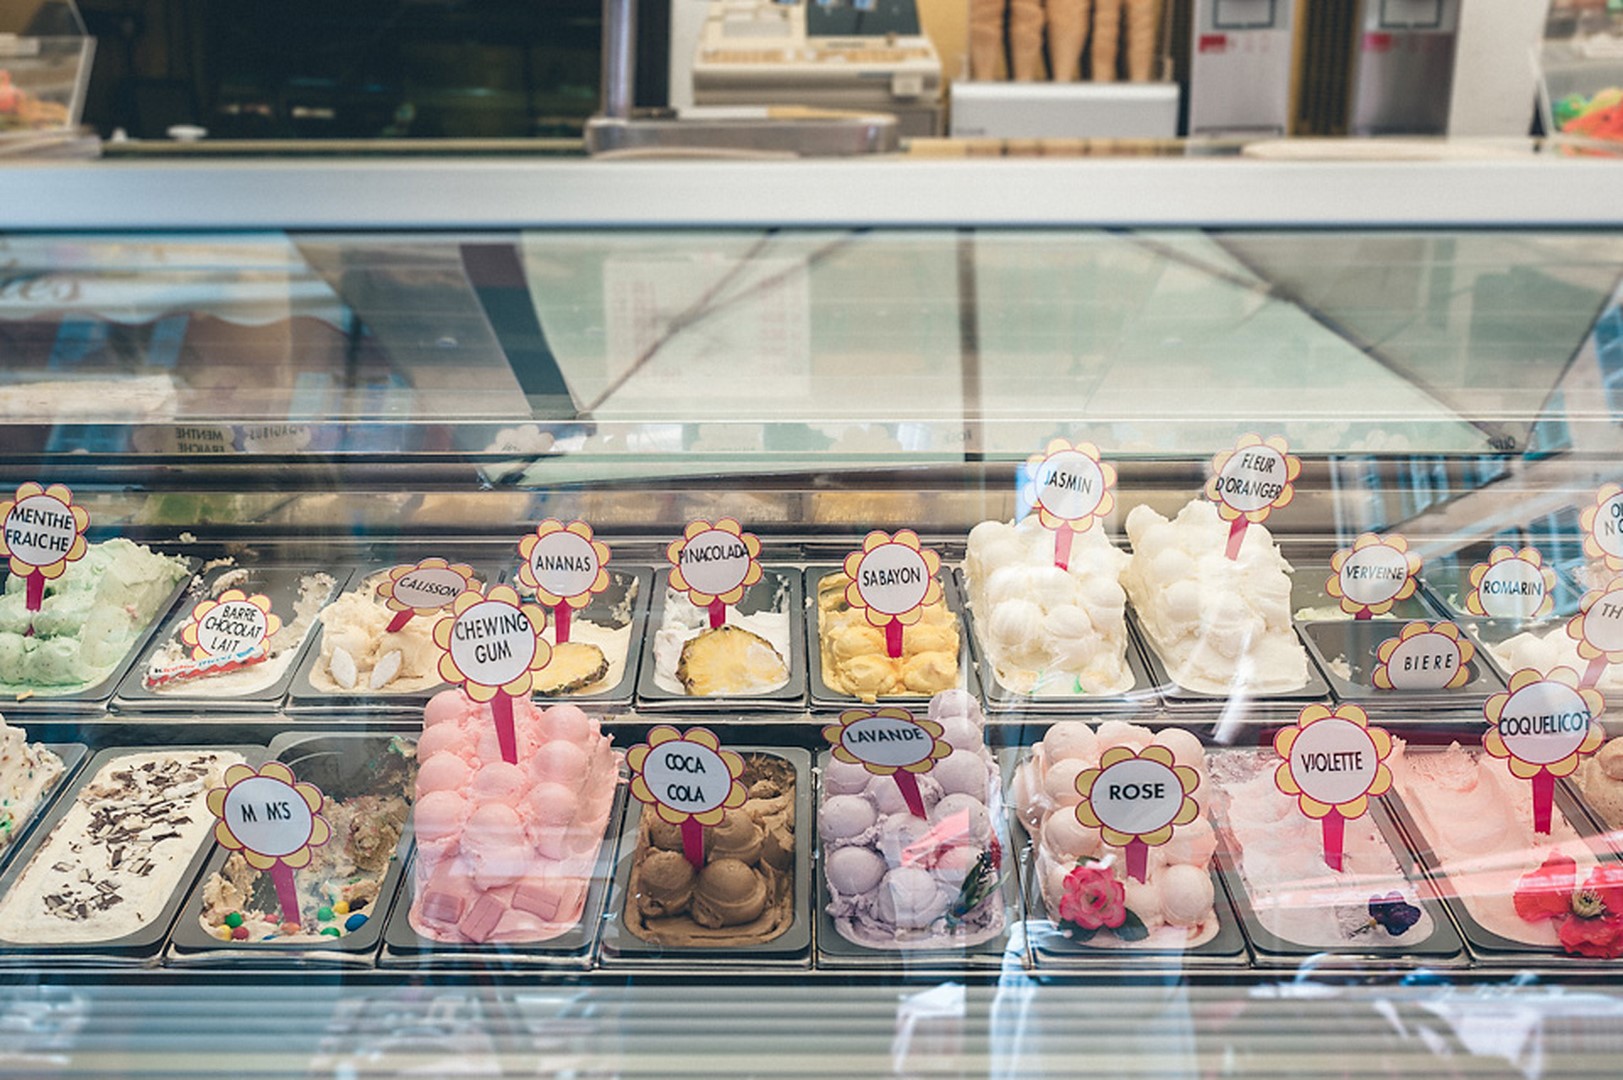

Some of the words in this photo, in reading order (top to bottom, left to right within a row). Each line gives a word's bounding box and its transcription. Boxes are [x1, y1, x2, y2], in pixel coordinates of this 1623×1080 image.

[1241, 453, 1276, 473] FLEUR
[1044, 470, 1093, 494] JASMIN
[1215, 476, 1283, 499] D'ORANGER
[10, 505, 73, 529] MENTHE
[5, 529, 69, 552] FRAICHE
[678, 543, 750, 564] PINACOLADA
[535, 556, 591, 572] ANANAS
[1346, 565, 1405, 580] VERVEINE
[863, 567, 921, 586] SABAYON
[400, 577, 461, 597] CALISSON
[1483, 581, 1542, 595] ROMARIN
[222, 605, 257, 621] BARRE
[205, 616, 262, 638] CHOCOLAT
[455, 612, 528, 641] CHEWING
[210, 637, 240, 652] LAIT
[474, 640, 512, 664] GUM
[1404, 653, 1454, 671] BIERE
[1499, 711, 1591, 736] COQUELICOT
[846, 728, 923, 743] LAVANDE
[665, 753, 706, 774] COCA
[1301, 751, 1363, 773] VIOLETTE
[667, 784, 705, 803] COLA
[1109, 783, 1165, 800] ROSE
[241, 804, 257, 822] M
